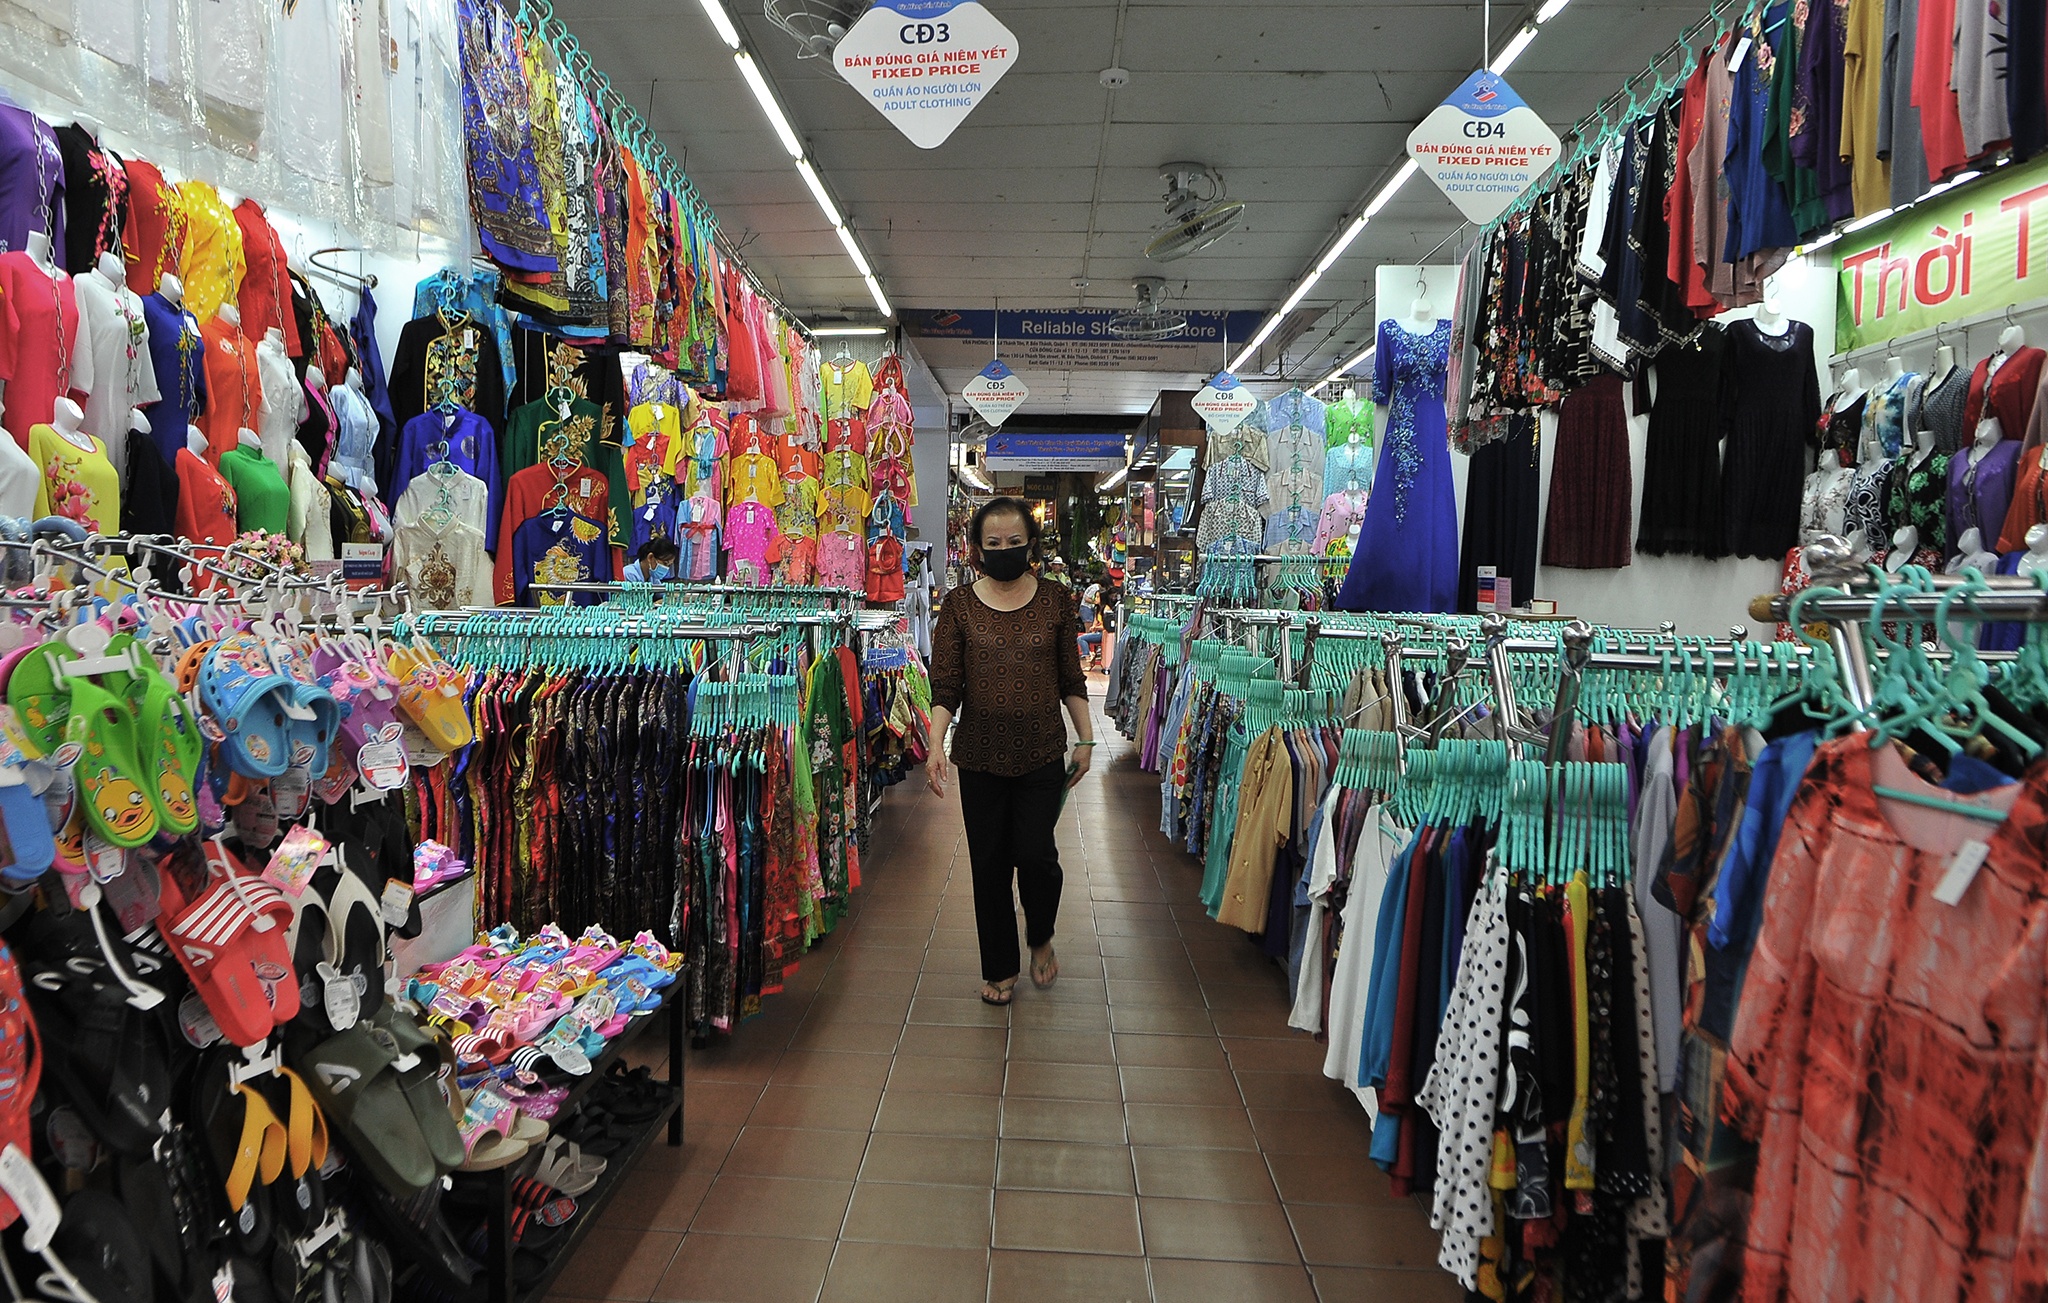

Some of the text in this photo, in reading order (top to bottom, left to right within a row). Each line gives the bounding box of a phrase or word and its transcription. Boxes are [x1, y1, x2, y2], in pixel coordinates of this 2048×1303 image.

[899, 23, 950, 44] CĐ3
[844, 45, 1008, 67] BÁN ĐÚNG GIÁ NIÊM YẾT
[871, 64, 981, 79] FIXED PRICE
[906, 84, 920, 96] ÁO
[923, 83, 957, 95] NGƯỜI
[960, 81, 981, 93] LỚN
[883, 97, 972, 111] ADULT CLOTHING
[1463, 121, 1506, 139] CĐ4
[1416, 142, 1552, 156] BÁN ĐÚNG GIÁ NIÊM YẾT
[1438, 156, 1529, 166] FIXED PRICE
[1465, 171, 1478, 181] ÁO
[1479, 171, 1510, 181] NGƯỜI
[1512, 171, 1529, 182] LỚN
[1446, 184, 1520, 193] ADULT CLOTHING
[1841, 183, 2048, 328] Thời T
[1021, 320, 1085, 335] Reliable
[986, 381, 1005, 390] CĐ5
[1215, 392, 1234, 401] CĐ8
